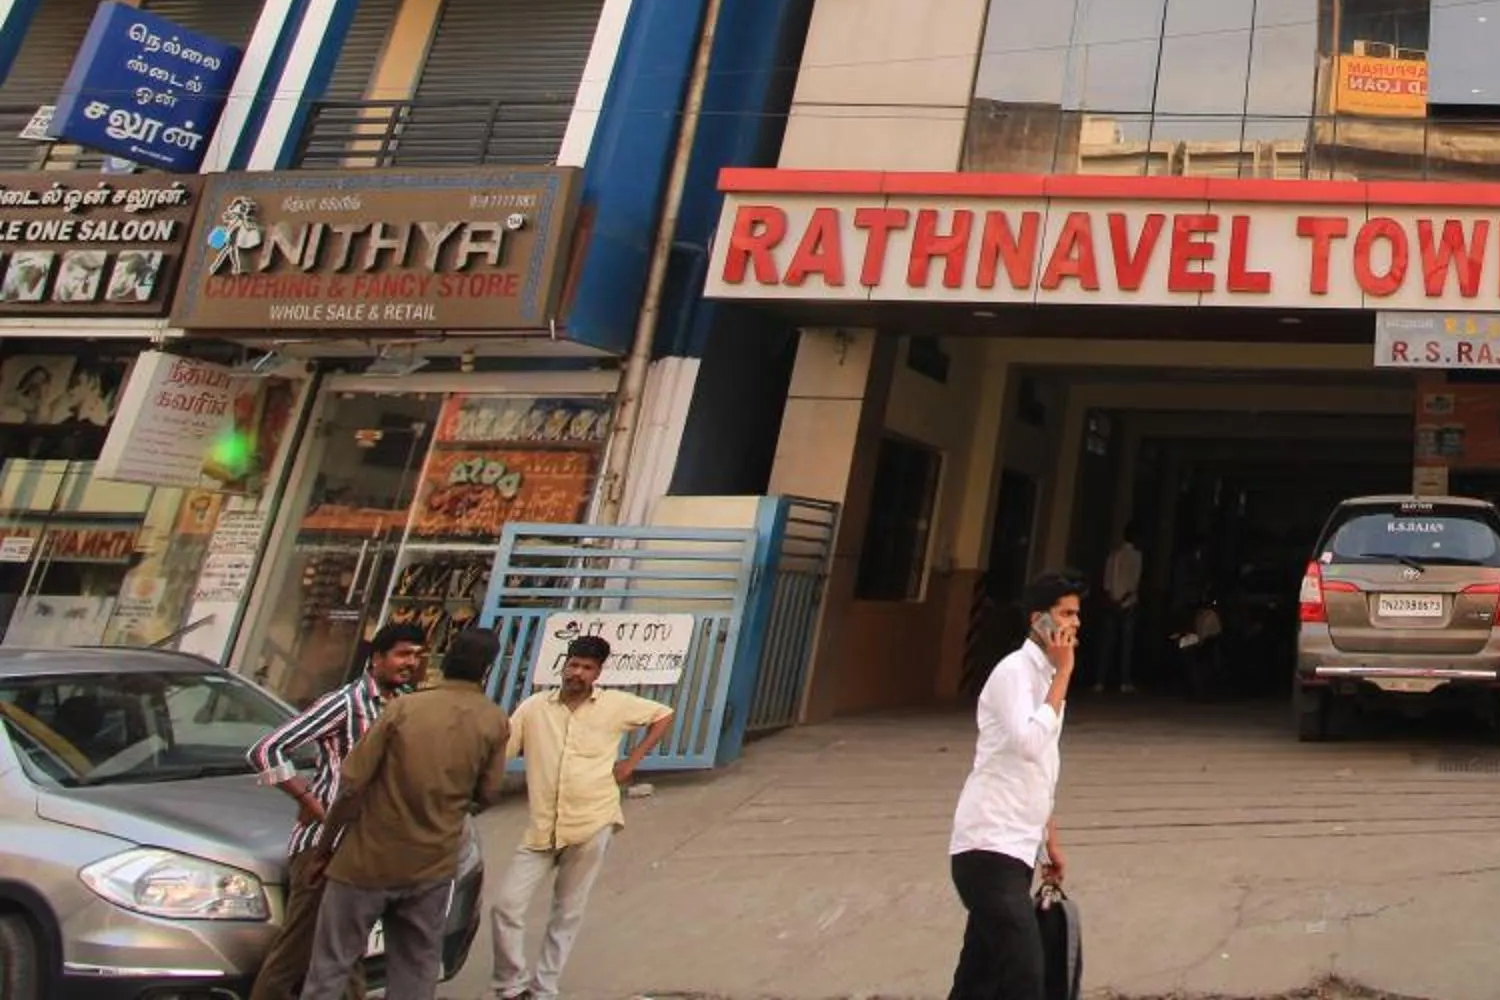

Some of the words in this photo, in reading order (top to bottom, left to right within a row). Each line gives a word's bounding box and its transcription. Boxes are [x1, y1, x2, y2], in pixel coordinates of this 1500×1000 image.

[129, 22, 221, 71] நெல்லை
[127, 55, 203, 94] ஸ்டைல்
[135, 87, 176, 109] ஒன்
[84, 101, 203, 151] சலூன்
[0, 181, 62, 206] டைல்
[25, 219, 76, 242] ONE
[77, 219, 176, 242] SALOON
[258, 220, 503, 273] NITHYA
[722, 205, 1271, 293] RATHNAVEL
[205, 274, 320, 299] COVERING
[327, 275, 347, 298] &
[351, 274, 434, 298] FANCY
[437, 273, 520, 298] STORE
[269, 303, 323, 322] WHOLE
[325, 303, 365, 321] SALE
[367, 304, 379, 320] &
[383, 302, 437, 321] RETAIL
